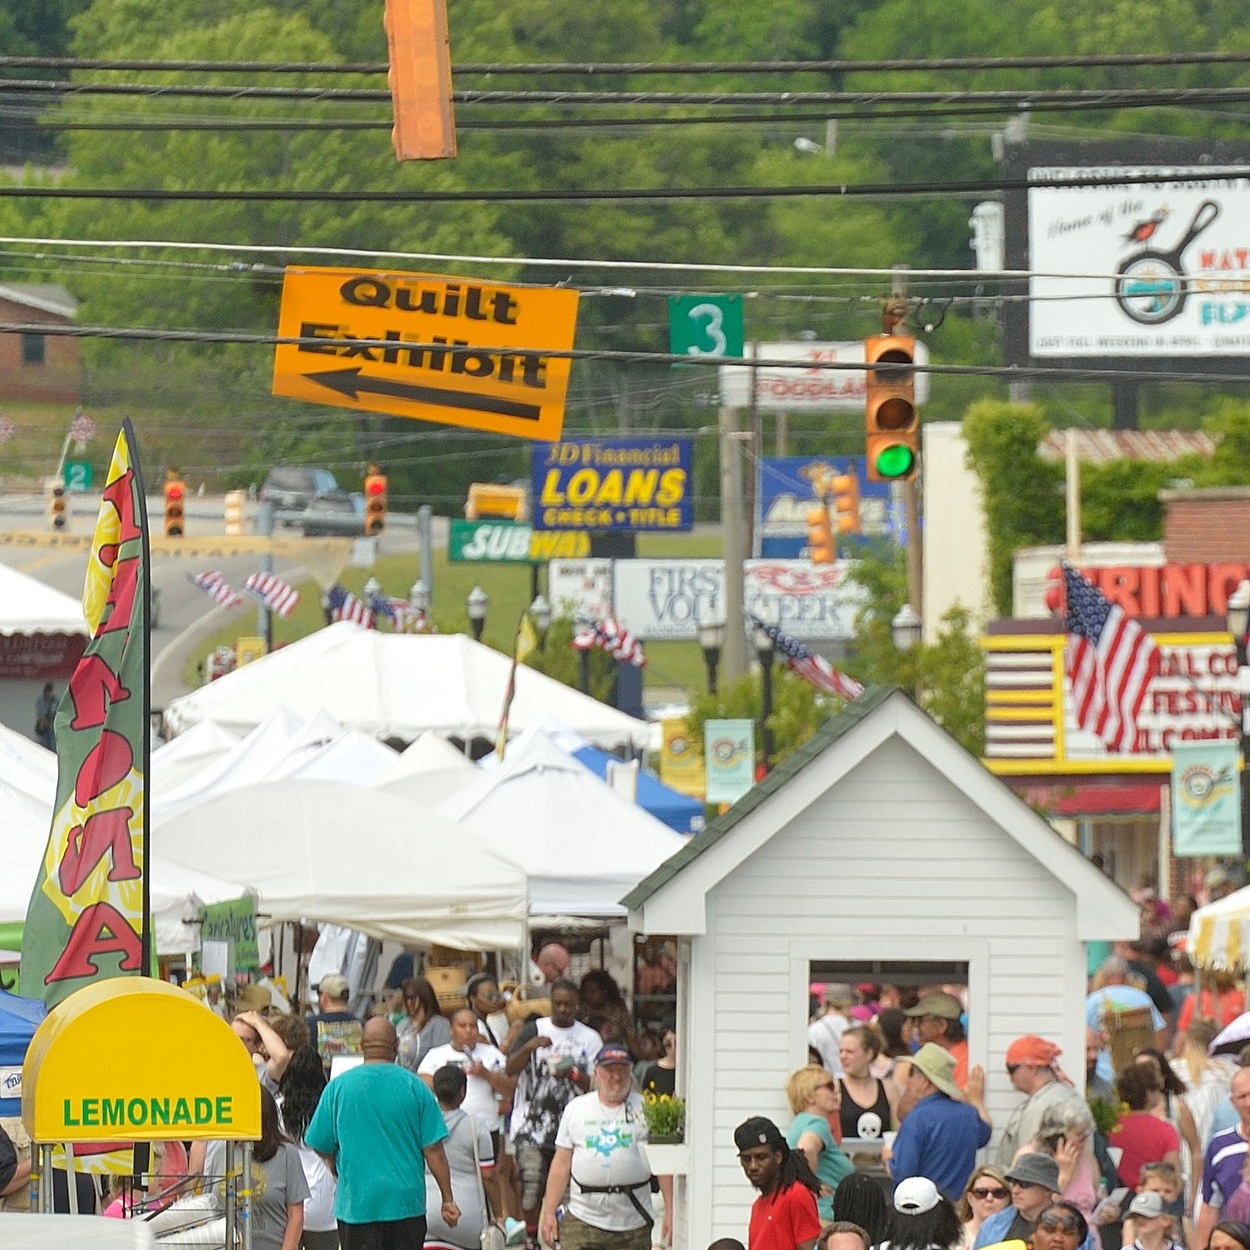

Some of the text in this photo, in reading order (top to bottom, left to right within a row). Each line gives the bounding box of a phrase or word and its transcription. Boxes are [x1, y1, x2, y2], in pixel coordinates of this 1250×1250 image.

[340, 276, 518, 325] Quilt
[688, 303, 727, 358] 3
[298, 322, 547, 389] Exhibit
[69, 464, 87, 490] 2
[540, 467, 688, 508] LOANS
[649, 565, 724, 595] FIRS
[63, 1096, 233, 1127] LEMONADE
